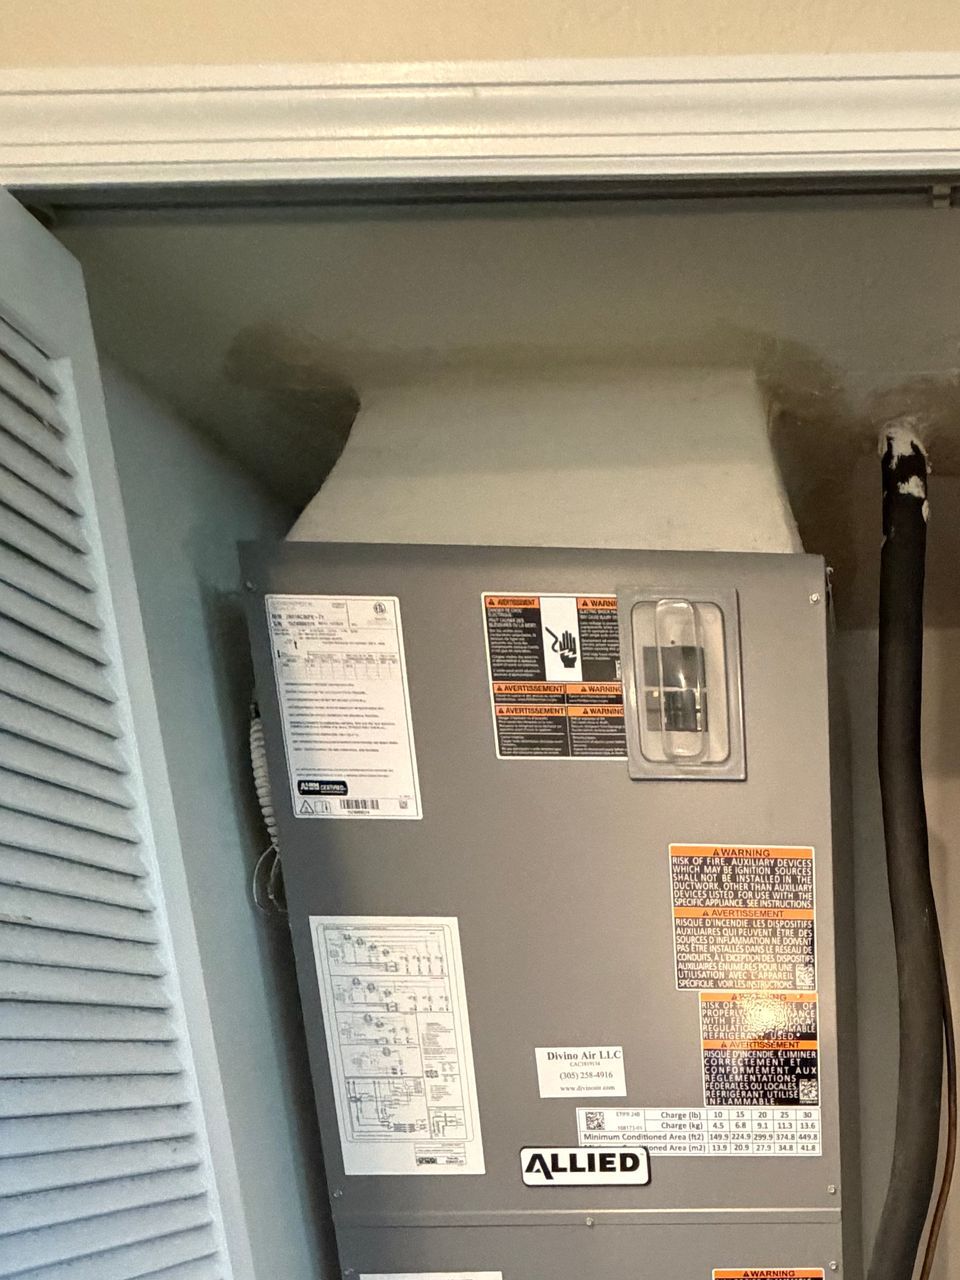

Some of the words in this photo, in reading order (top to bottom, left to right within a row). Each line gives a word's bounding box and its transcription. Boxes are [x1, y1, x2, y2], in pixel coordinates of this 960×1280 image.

[721, 848, 770, 858] WARNING
[672, 857, 689, 865] RISK
[692, 857, 703, 865] OF
[707, 858, 729, 866] FIRE.
[731, 858, 774, 867] AUXILIARY
[777, 859, 812, 867] DEVICES
[704, 866, 721, 874] MAY
[723, 866, 733, 874] BE
[735, 867, 771, 875] IGNITION
[775, 867, 812, 876] SOURCES
[673, 874, 698, 882] SHALL
[736, 875, 781, 883] INSTALLED
[782, 875, 792, 883] IN
[797, 876, 812, 884] THE
[723, 883, 749, 891] OTHER
[750, 883, 772, 891] THAN
[774, 884, 813, 892] AUXILIARY
[673, 890, 707, 898] DEVICES
[709, 891, 734, 899] LISTED
[738, 891, 753, 899] FOR
[755, 891, 770, 899] USE
[799, 892, 812, 900] THE
[747, 899, 759, 907] SEE
[711, 909, 784, 918] AVERTISSEMENT
[729, 1041, 800, 1049] AVERTISSEMENT
[547, 1051, 579, 1061] Divino
[581, 1051, 596, 1060] Air
[599, 1050, 621, 1059] LLC
[559, 1072, 579, 1080] (305)
[580, 1071, 614, 1079] 258-4916
[660, 1111, 686, 1120] Charge
[688, 1111, 702, 1120] (lb)
[758, 1111, 768, 1119] 20
[661, 1122, 687, 1130] Charge
[689, 1121, 703, 1130] (kg)
[583, 1133, 620, 1141] Minimum
[622, 1133, 668, 1141] Conditioned
[669, 1133, 686, 1141] Area
[688, 1132, 705, 1142] (ft2)
[669, 1144, 687, 1152] Area
[688, 1143, 706, 1152] (m2)
[712, 1144, 728, 1152] 13.9
[756, 1144, 772, 1152] 27.9
[778, 1144, 794, 1152] 34.8
[800, 1144, 816, 1152] 41.8
[525, 1153, 640, 1180] ALLIED
